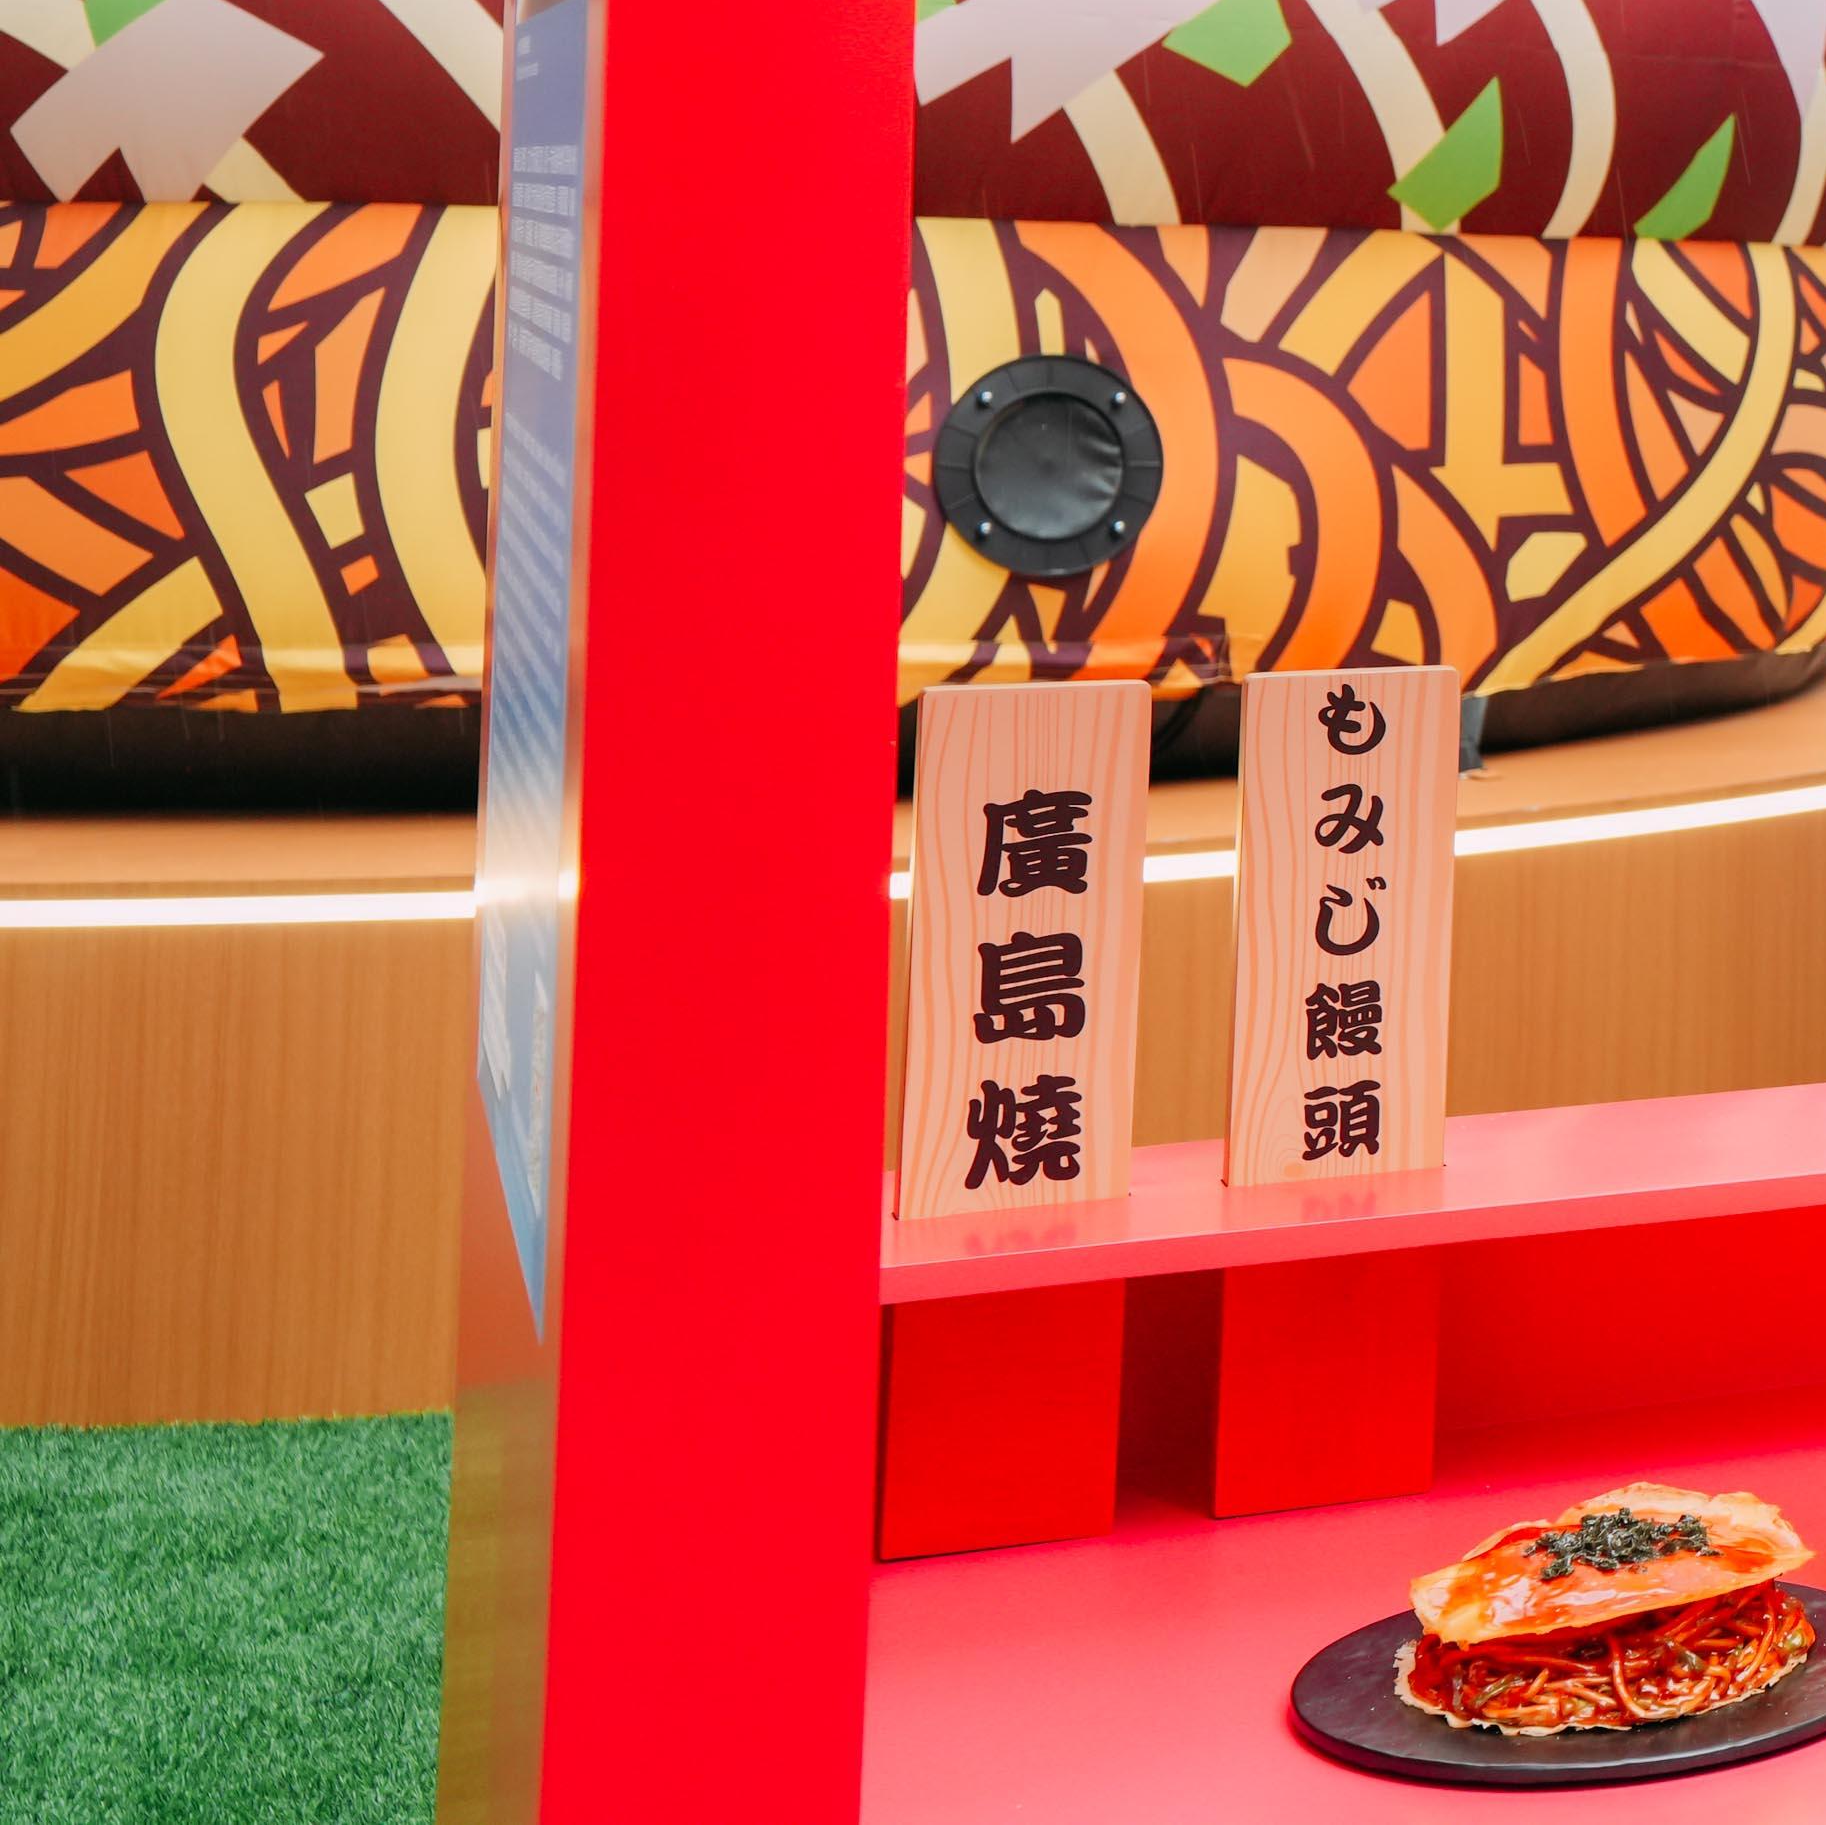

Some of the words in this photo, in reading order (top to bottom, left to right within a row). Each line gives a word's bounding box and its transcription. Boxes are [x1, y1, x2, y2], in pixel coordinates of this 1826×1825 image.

[964, 789, 1092, 1190] 廣島燒
[1302, 684, 1386, 1162] もみじ饅頭
